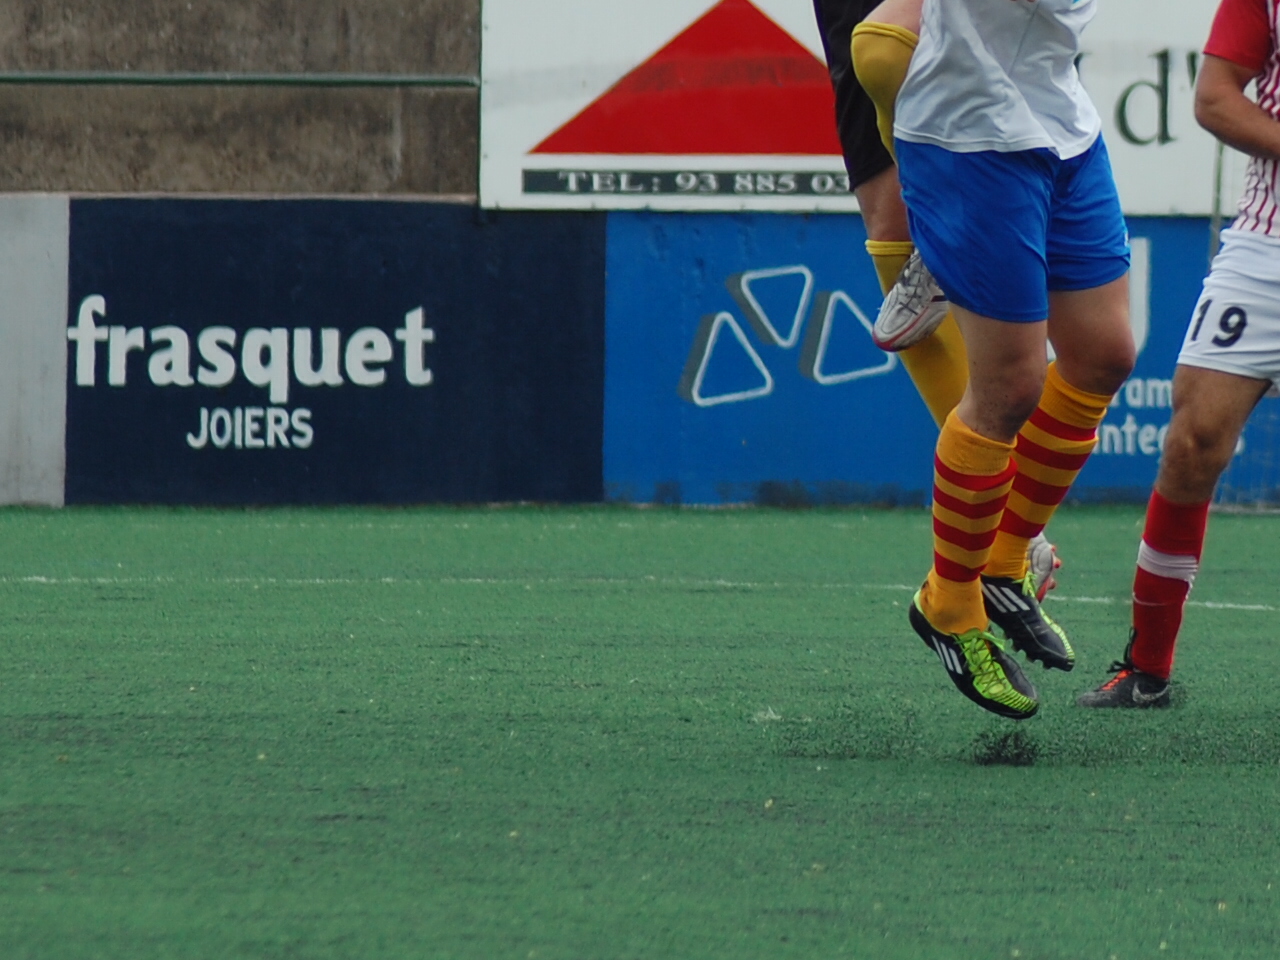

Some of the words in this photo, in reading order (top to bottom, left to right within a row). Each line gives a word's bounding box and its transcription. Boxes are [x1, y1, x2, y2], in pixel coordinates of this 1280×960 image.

[557, 171, 660, 192] TEL:
[675, 172, 717, 192] 93
[734, 172, 794, 193] 885
[1190, 296, 1249, 349] 19
[66, 294, 436, 405] frasquet
[186, 406, 315, 450] JOIERS
